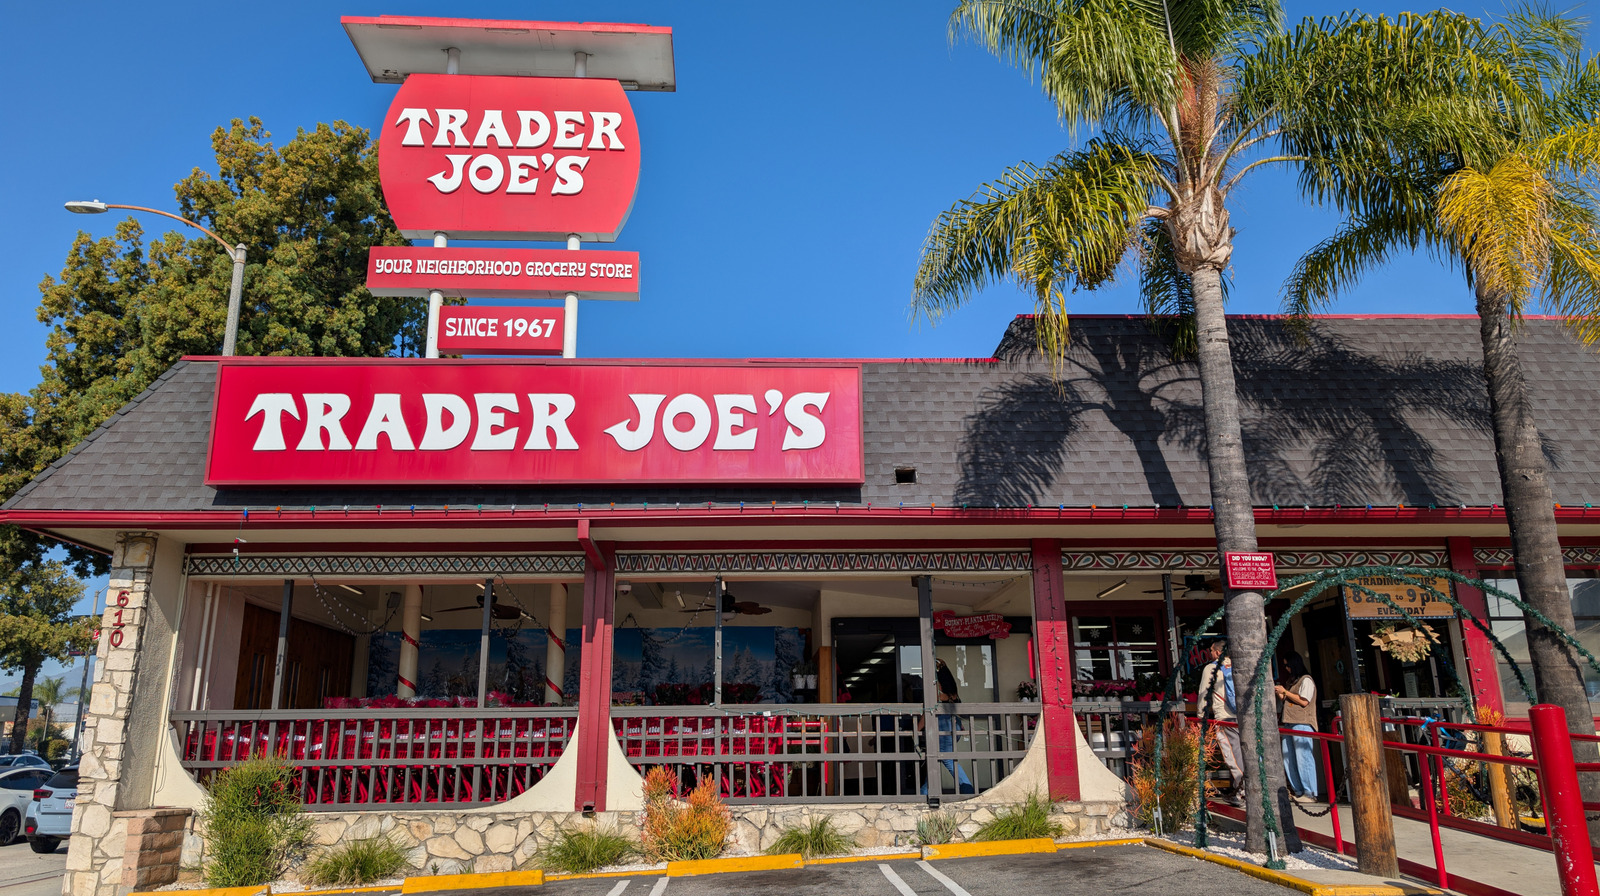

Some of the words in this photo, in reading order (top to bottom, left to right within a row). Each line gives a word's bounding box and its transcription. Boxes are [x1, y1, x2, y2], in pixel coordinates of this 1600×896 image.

[395, 108, 625, 150] TRADER
[427, 153, 590, 195] JOE'S
[375, 258, 412, 274] YOUR
[415, 259, 522, 276] NEIGHBORHOOD
[525, 261, 586, 277] GROCERY
[589, 263, 633, 279] STORE
[445, 317, 498, 337] SINCE
[503, 318, 556, 338] 1967
[244, 393, 580, 452] TRADER
[604, 389, 831, 452] JOE'S
[1352, 587, 1362, 603] 8
[1406, 588, 1416, 603] 9
[1358, 576, 1401, 585] TRADING
[110, 590, 130, 647] 610
